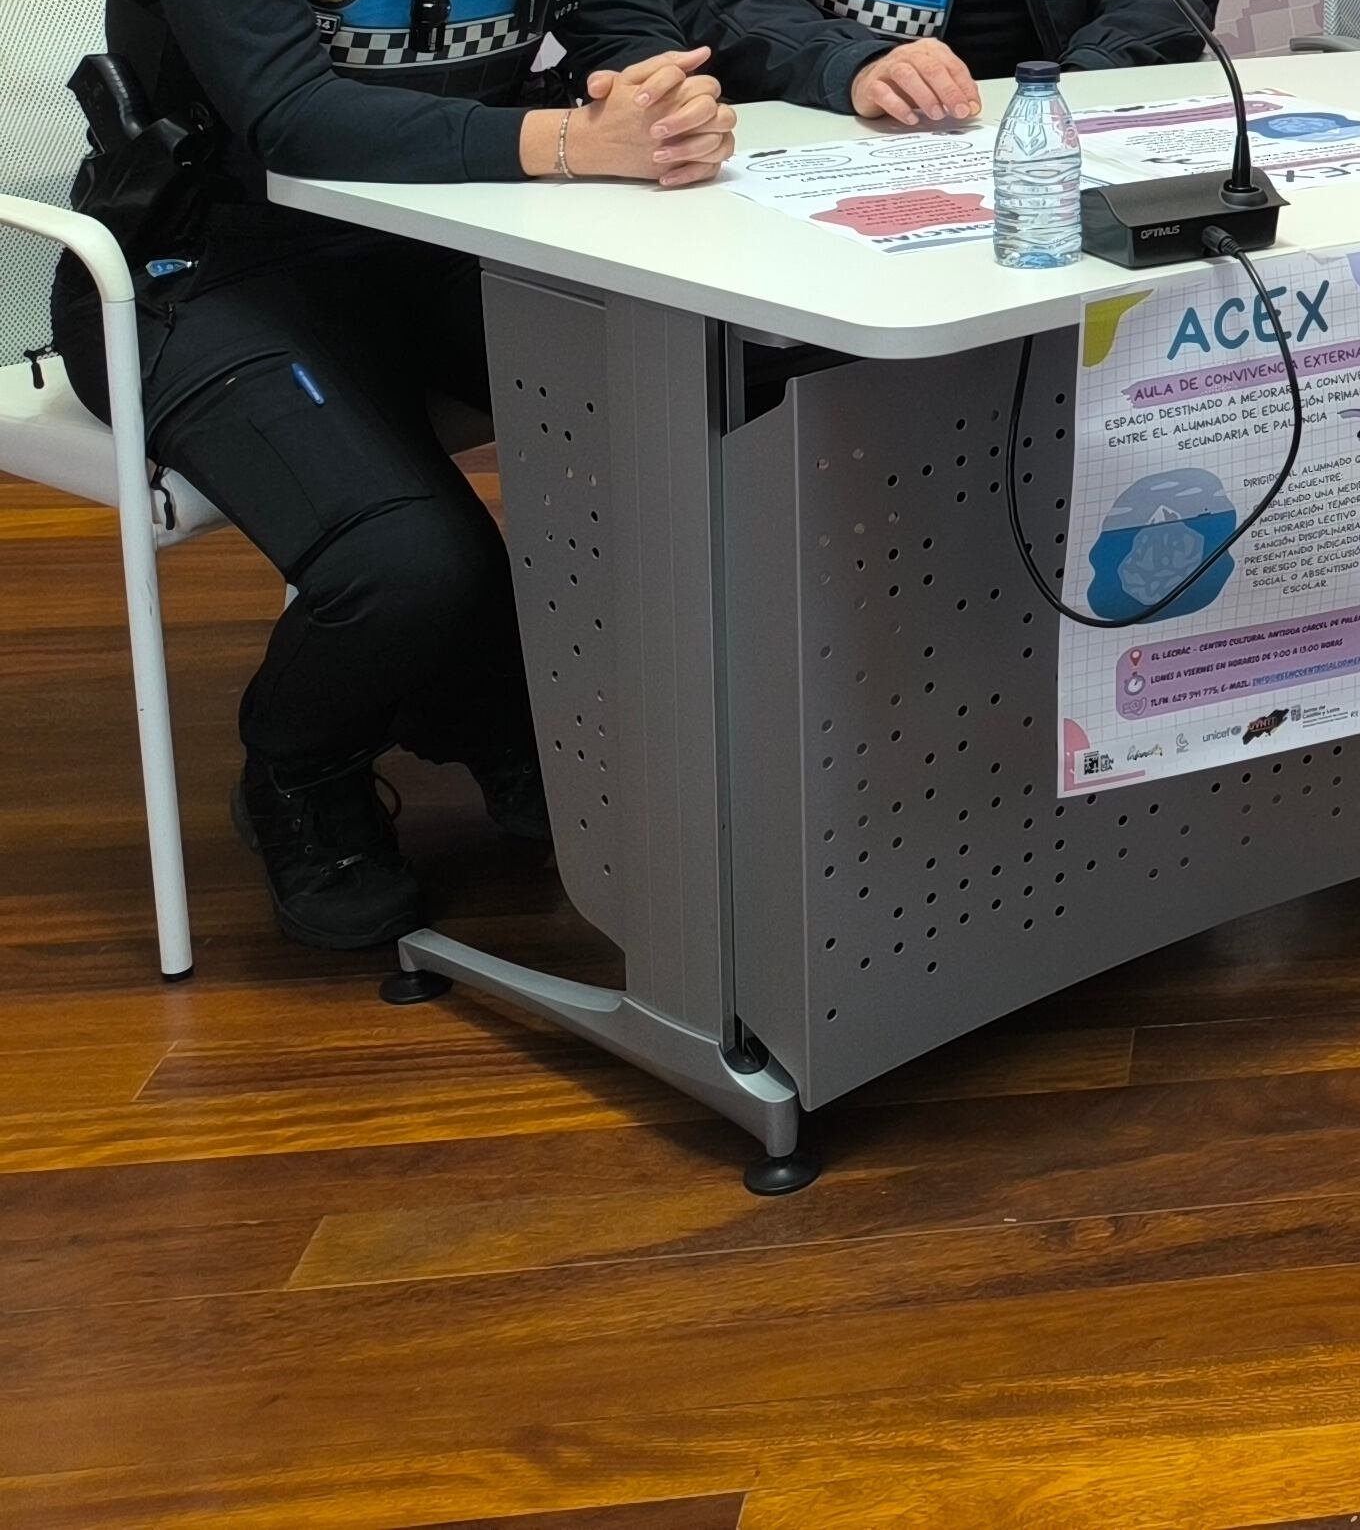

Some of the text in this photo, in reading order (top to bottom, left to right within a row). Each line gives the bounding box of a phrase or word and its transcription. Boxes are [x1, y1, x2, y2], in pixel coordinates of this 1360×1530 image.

[1167, 280, 1329, 361] ACEX
[1134, 383, 1174, 401] AULA
[1178, 376, 1200, 391] DE
[1204, 361, 1298, 387] CONVIVENCA
[1105, 412, 1154, 430] ESPACIO
[1159, 398, 1222, 419] DESTINADO
[1227, 396, 1238, 406] A
[1241, 383, 1294, 404] MEJORAR
[1108, 429, 1150, 447] ENTRE
[1152, 426, 1168, 438] EL
[1172, 412, 1236, 434] ALUMNADO
[1241, 407, 1258, 419] DE
[1261, 392, 1324, 416] EDUCCIÓN
[1177, 410, 1328, 450] SECUNDARIA DE PALNCIA
